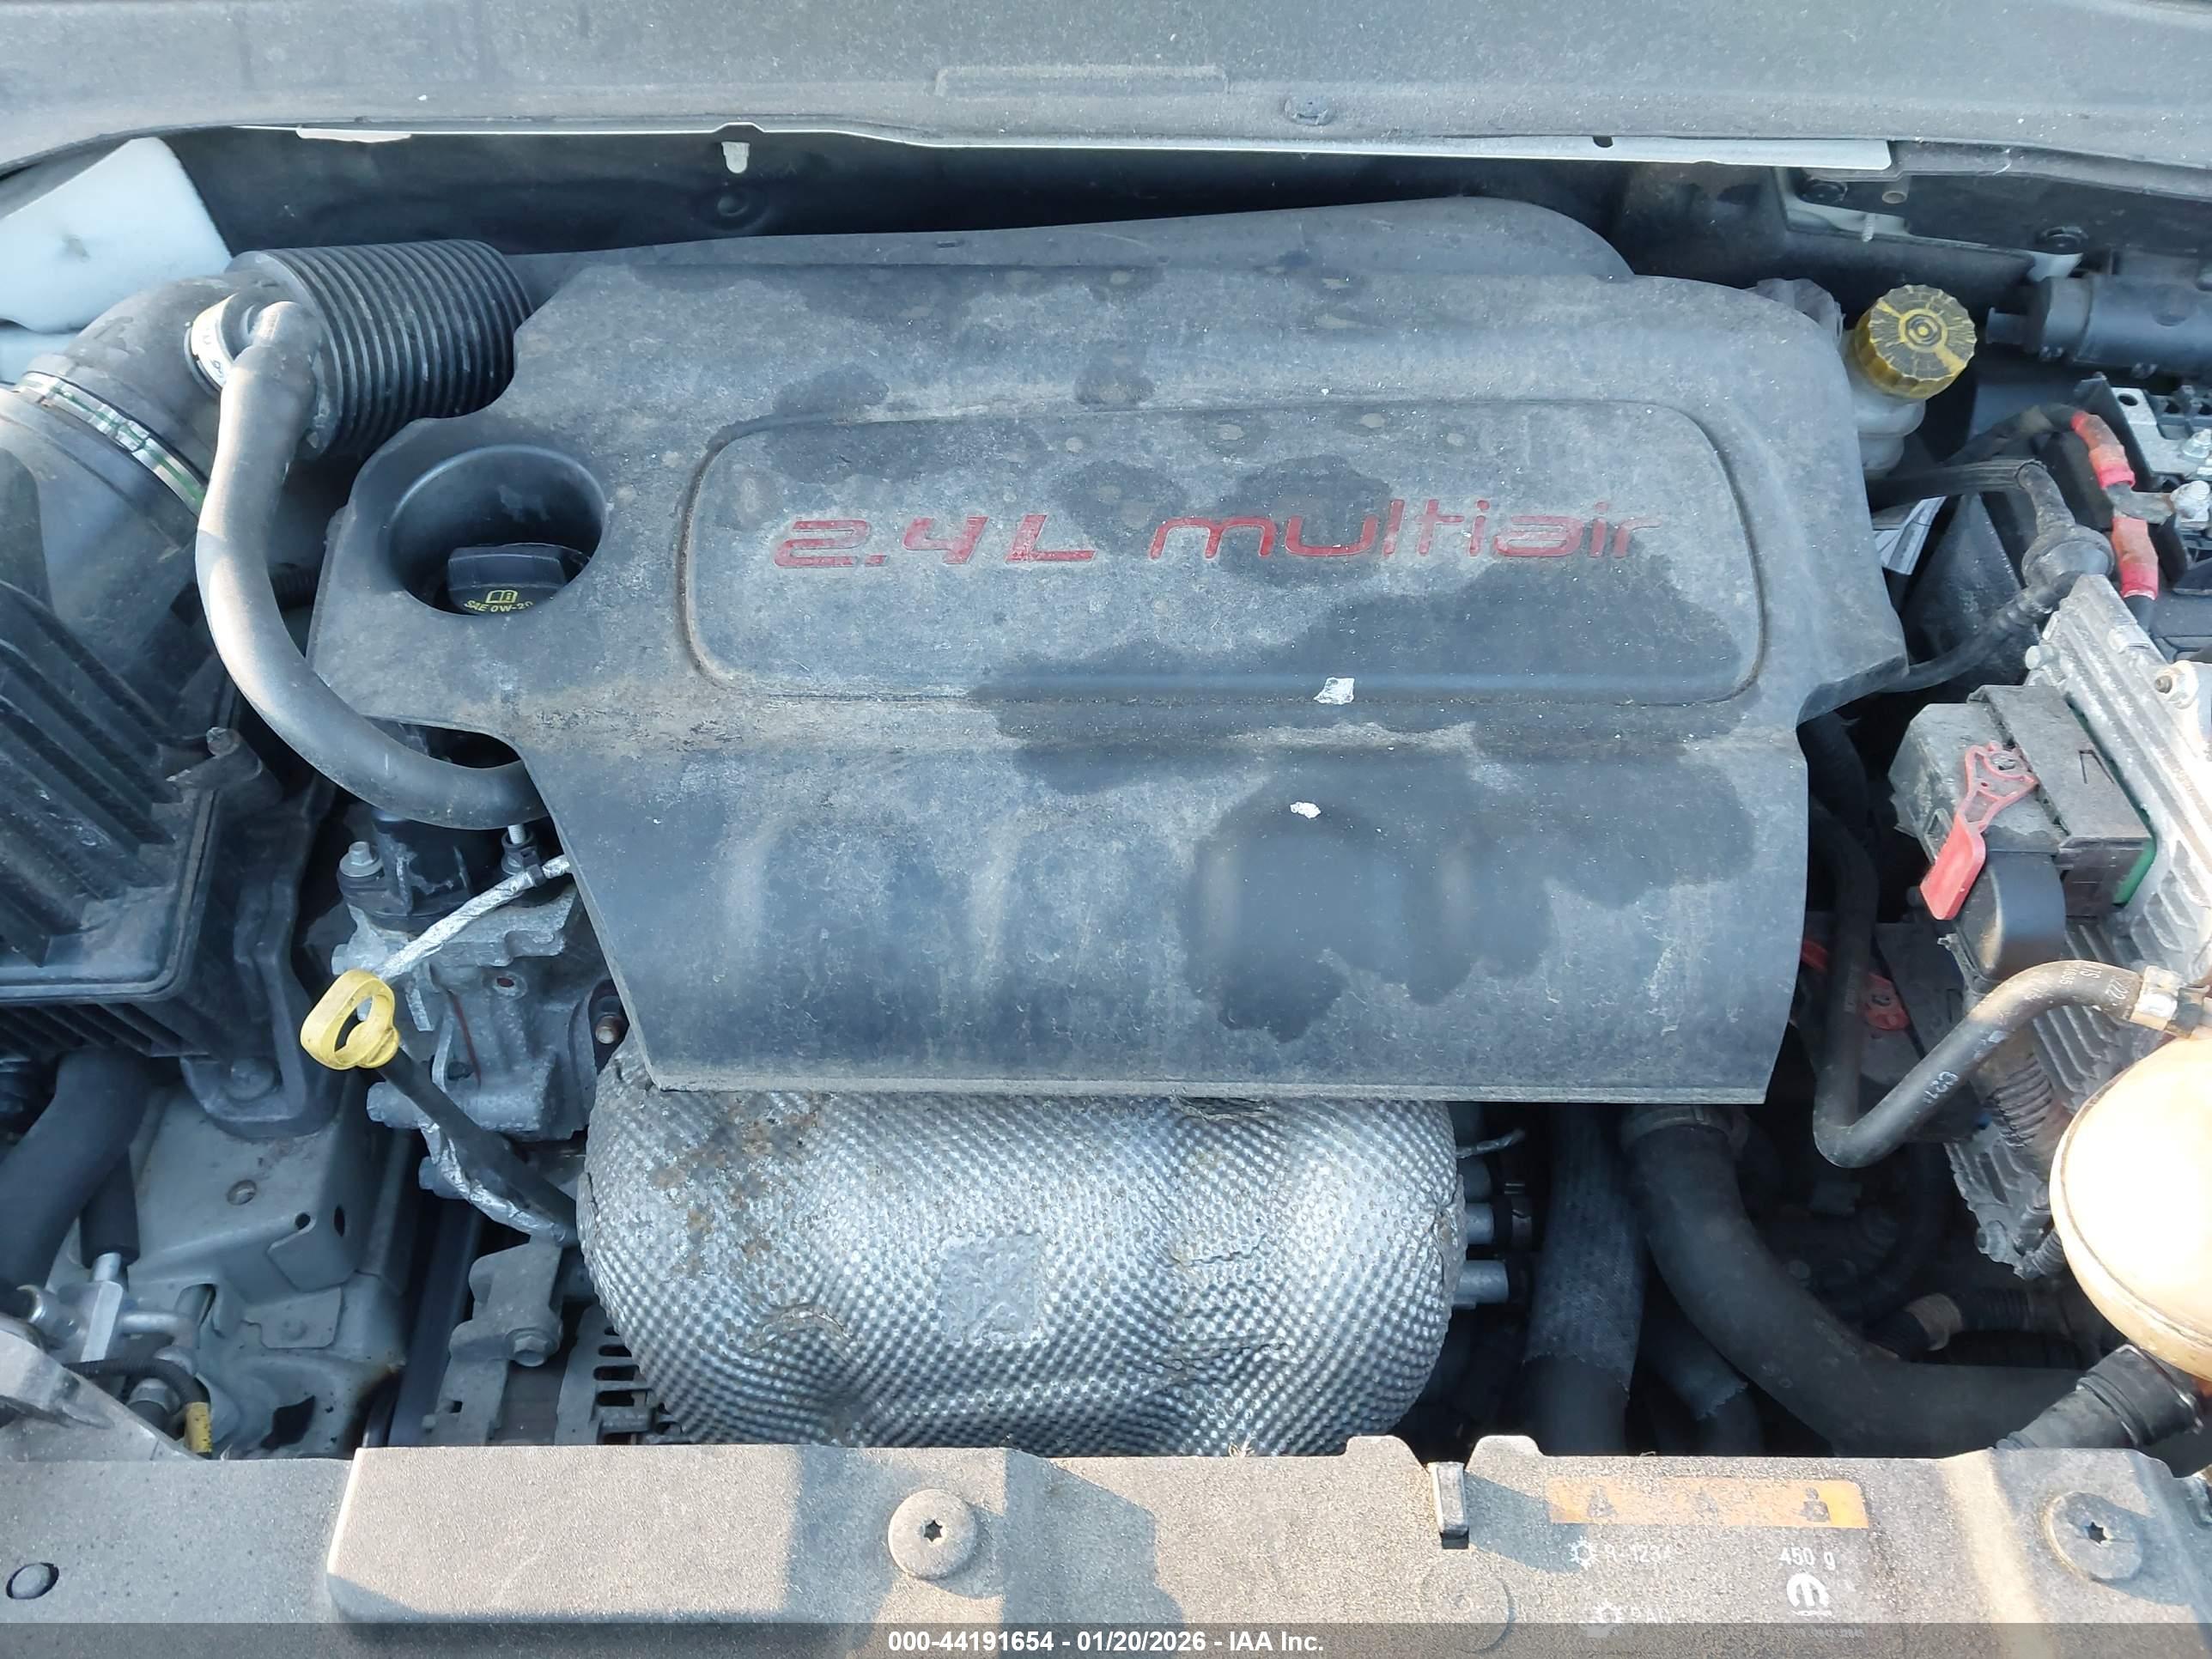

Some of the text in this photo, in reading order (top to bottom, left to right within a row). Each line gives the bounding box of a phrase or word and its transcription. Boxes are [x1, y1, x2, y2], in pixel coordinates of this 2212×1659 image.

[1148, 499, 1662, 560] multiair
[464, 599, 489, 612] SAE
[1778, 1547, 1836, 1571] 450 g
